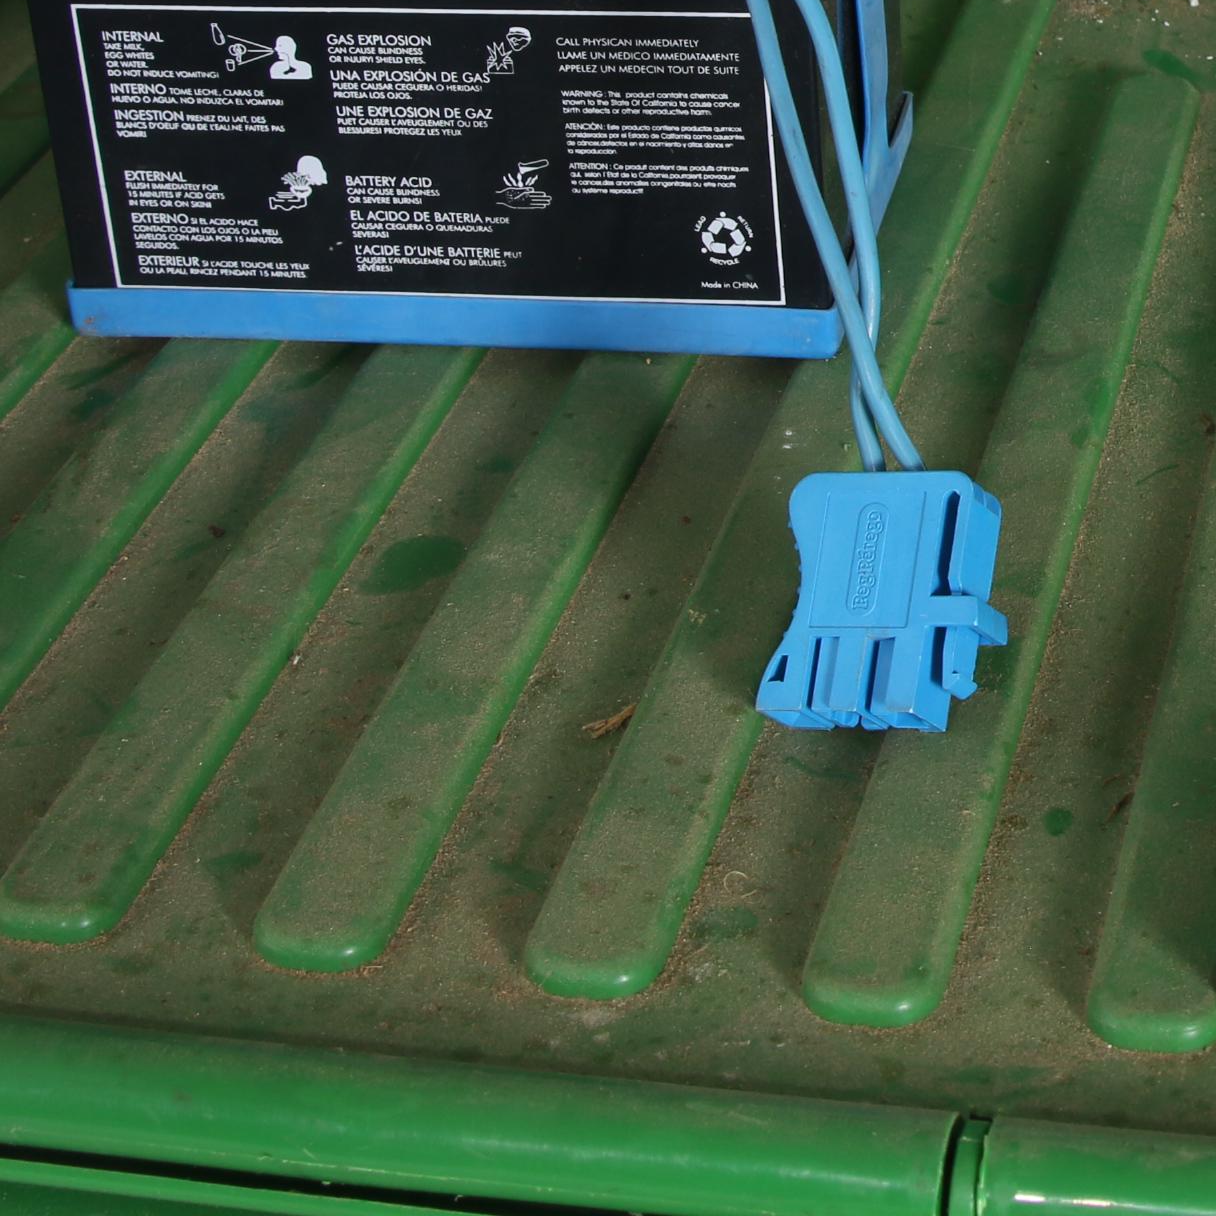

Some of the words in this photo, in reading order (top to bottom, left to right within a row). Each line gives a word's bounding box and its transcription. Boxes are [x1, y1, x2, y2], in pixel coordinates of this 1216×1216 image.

[102, 30, 164, 42] INTERNAL
[327, 34, 354, 46] GAS
[358, 34, 431, 46] EXPLOSION
[556, 38, 579, 46] CALL
[583, 38, 632, 47] PHYSICAN
[636, 39, 698, 48] IMMEDIATELY
[557, 52, 586, 60] LLAME
[591, 52, 605, 60] UN
[609, 52, 650, 61] MEDICO
[654, 53, 739, 62] IMMEDIATAMENTE
[559, 65, 597, 73] APPELEZ
[601, 65, 615, 74] UN
[619, 66, 664, 74] MEDECIN
[668, 66, 693, 74] TOUT
[698, 66, 709, 75] DE
[714, 66, 739, 75] SUITE
[330, 70, 360, 81] UNA
[364, 69, 437, 83] EXPLOSIÓN
[441, 72, 458, 83] DE
[463, 72, 490, 84] GAS
[110, 83, 167, 95] INTERNO
[114, 110, 184, 122] INGESTION
[336, 106, 364, 117] UNE
[368, 106, 440, 118] EXPLOSION
[444, 108, 461, 119] DE
[465, 108, 493, 120] GAZ
[124, 170, 187, 182] EXTERNAL
[345, 175, 396, 187] BATTERY
[400, 176, 432, 188] ACID
[131, 213, 189, 224] EXTERNO
[350, 210, 364, 221] EL
[367, 210, 410, 222] ACIDO
[414, 211, 430, 223] DE
[434, 212, 483, 224] BATERIA
[355, 245, 400, 256] L'ACIDE
[404, 246, 444, 257] D'UNE
[448, 247, 501, 258] BATTERIE
[138, 255, 200, 267] EXTERIEUR
[709, 257, 740, 265] RECYCLE
[701, 281, 722, 289] Made
[724, 281, 730, 289] in
[732, 281, 759, 289] CHINA
